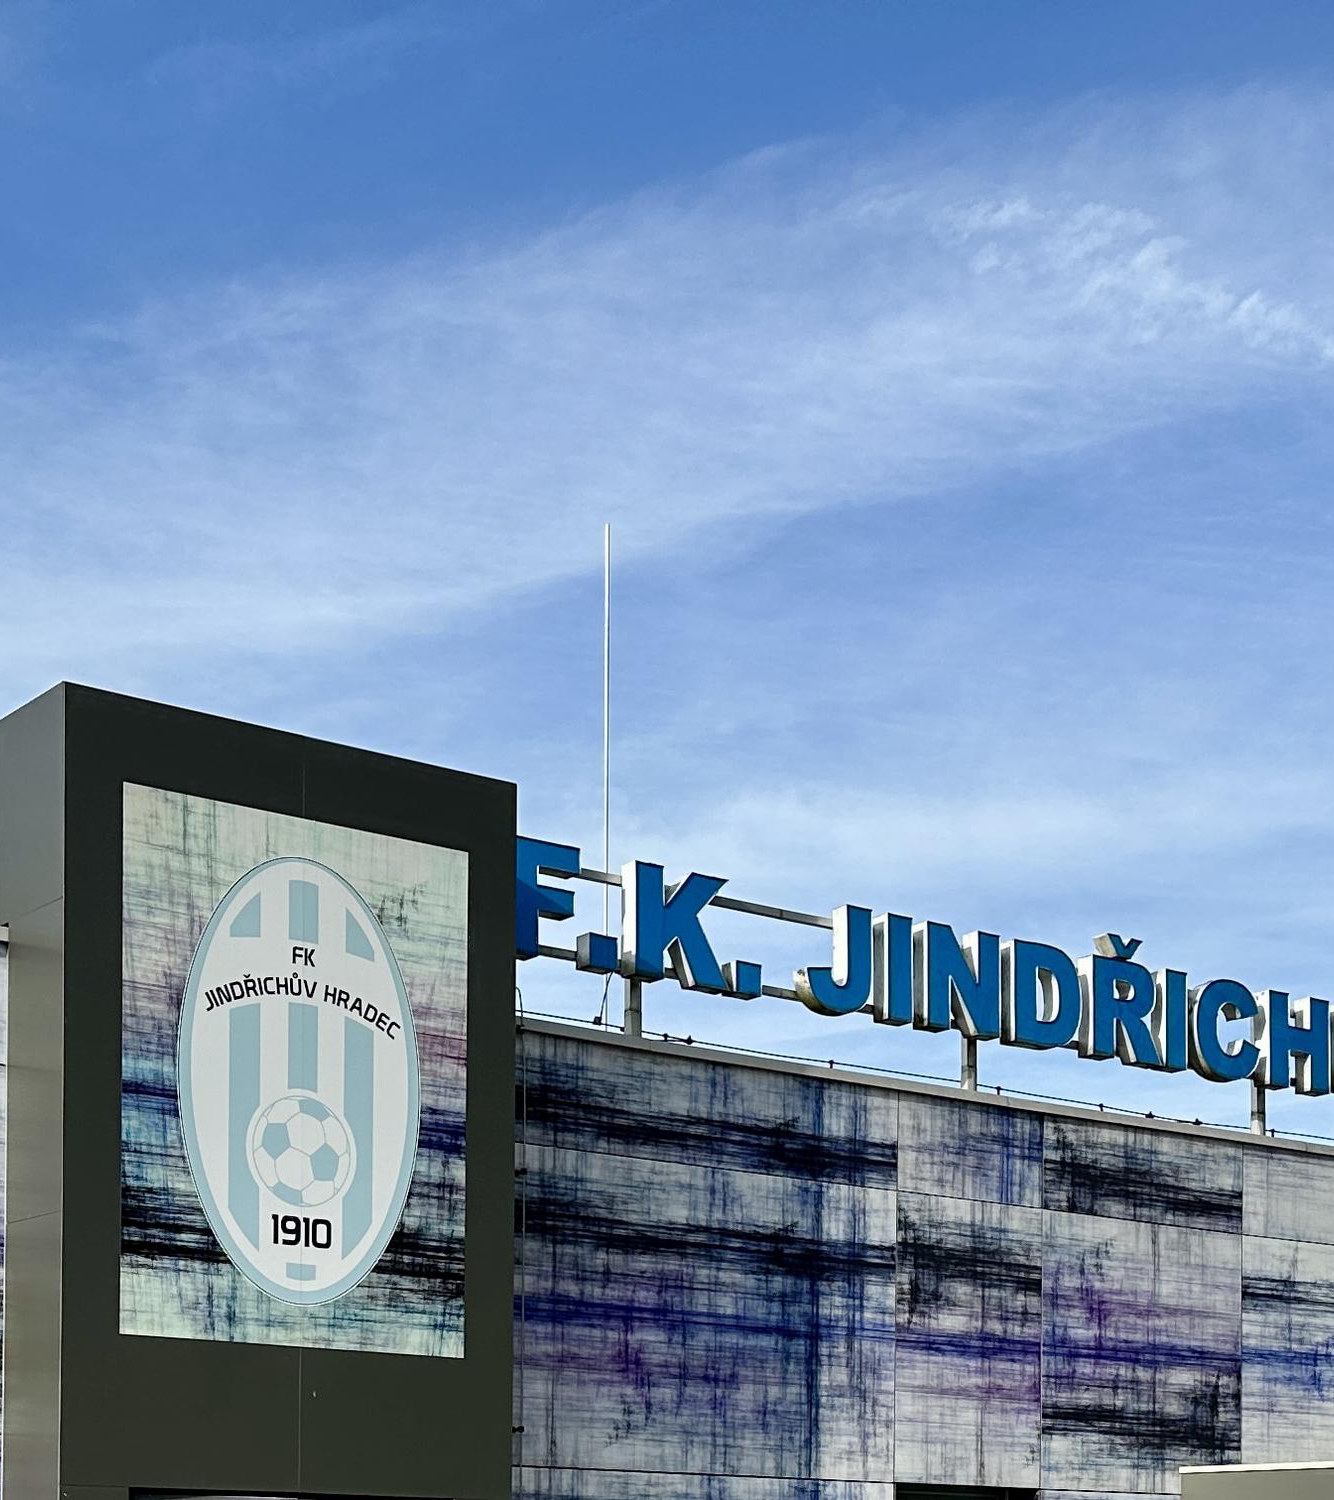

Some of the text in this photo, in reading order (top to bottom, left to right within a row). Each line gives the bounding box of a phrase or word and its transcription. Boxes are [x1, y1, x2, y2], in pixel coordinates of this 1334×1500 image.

[291, 945, 316, 968] FK
[204, 971, 402, 1041] JINDŘICHŮV HRADEC
[271, 1213, 333, 1250] 1910
